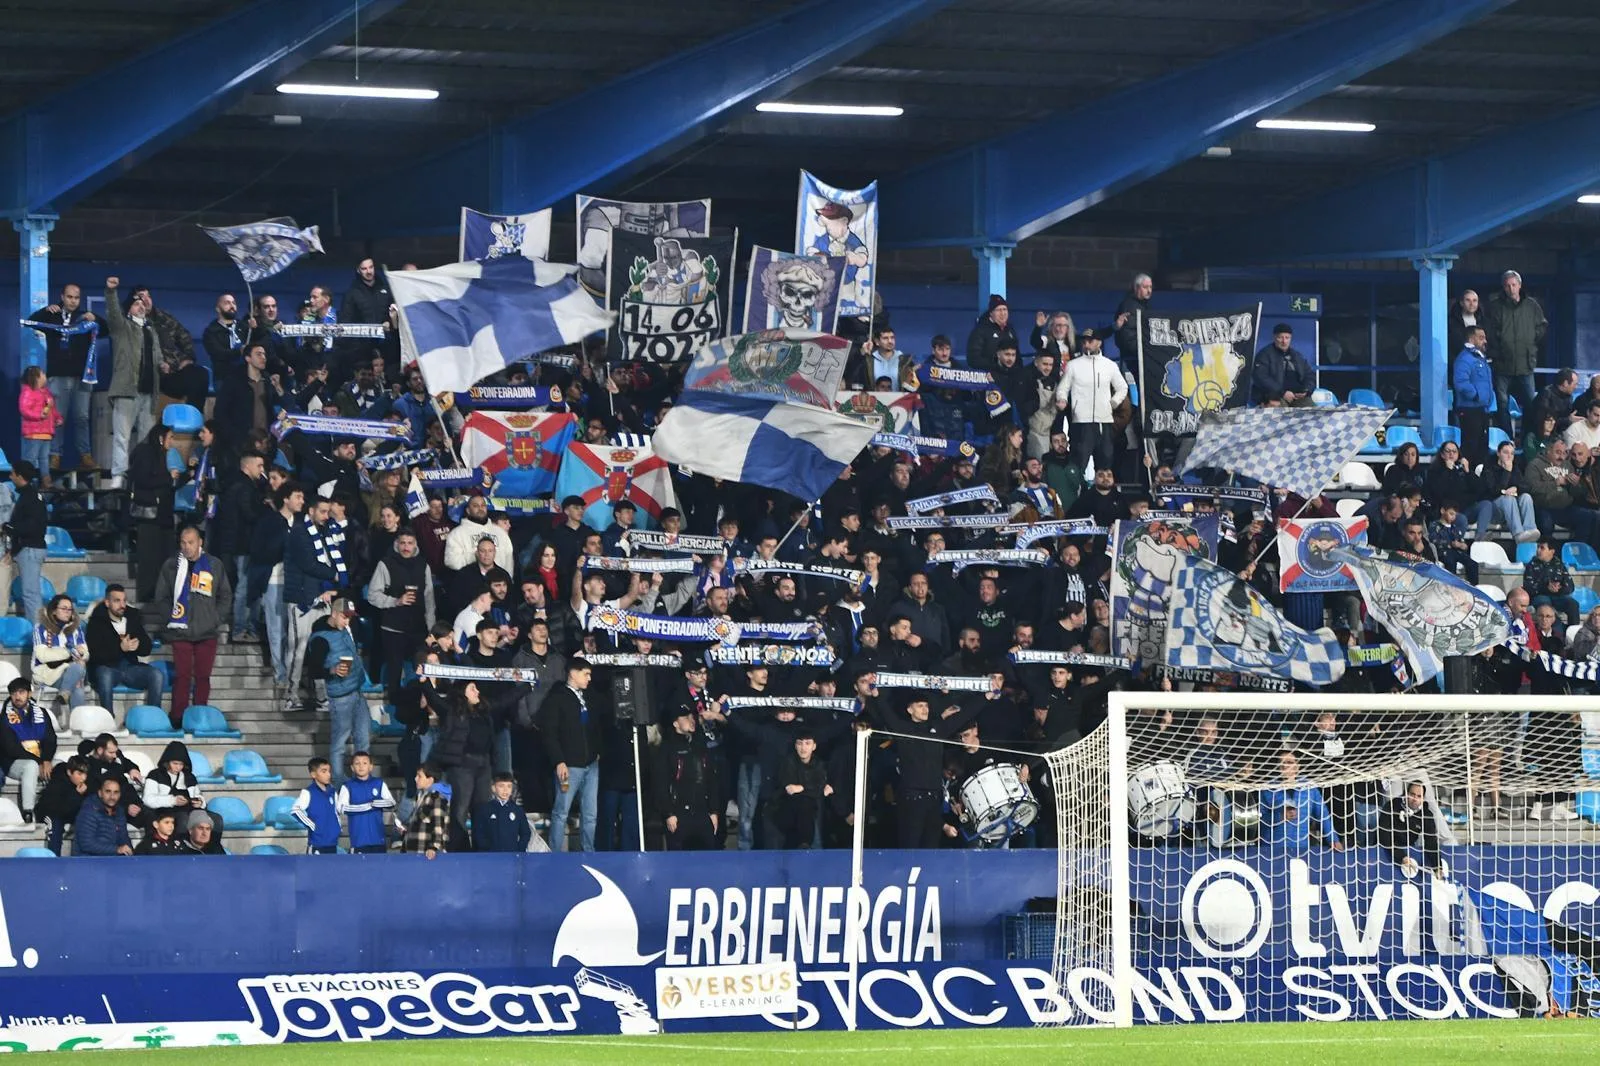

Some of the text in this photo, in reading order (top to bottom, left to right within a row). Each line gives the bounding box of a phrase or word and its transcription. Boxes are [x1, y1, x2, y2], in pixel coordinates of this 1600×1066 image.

[1149, 312, 1252, 346] EL BIERZO
[1150, 409, 1200, 436] BLAN
[955, 514, 1009, 526] BLANQUIAZU
[811, 564, 861, 581] NORTE
[626, 616, 709, 637] SDPONFERRADINA
[1017, 650, 1130, 668] FRENTE NORTE
[880, 675, 990, 691] FRENTE NORTE
[1156, 664, 1289, 693] FRENTE NORTE
[732, 696, 849, 711] FRENTE NORTE
[666, 866, 943, 965] ERBIENERGÍA
[273, 978, 420, 993] ELEVACIONES
[686, 971, 792, 996] VERSUS
[246, 978, 573, 1039] JopeCar
[699, 995, 783, 1009] E-LEARNING
[63, 1013, 87, 1026] de
